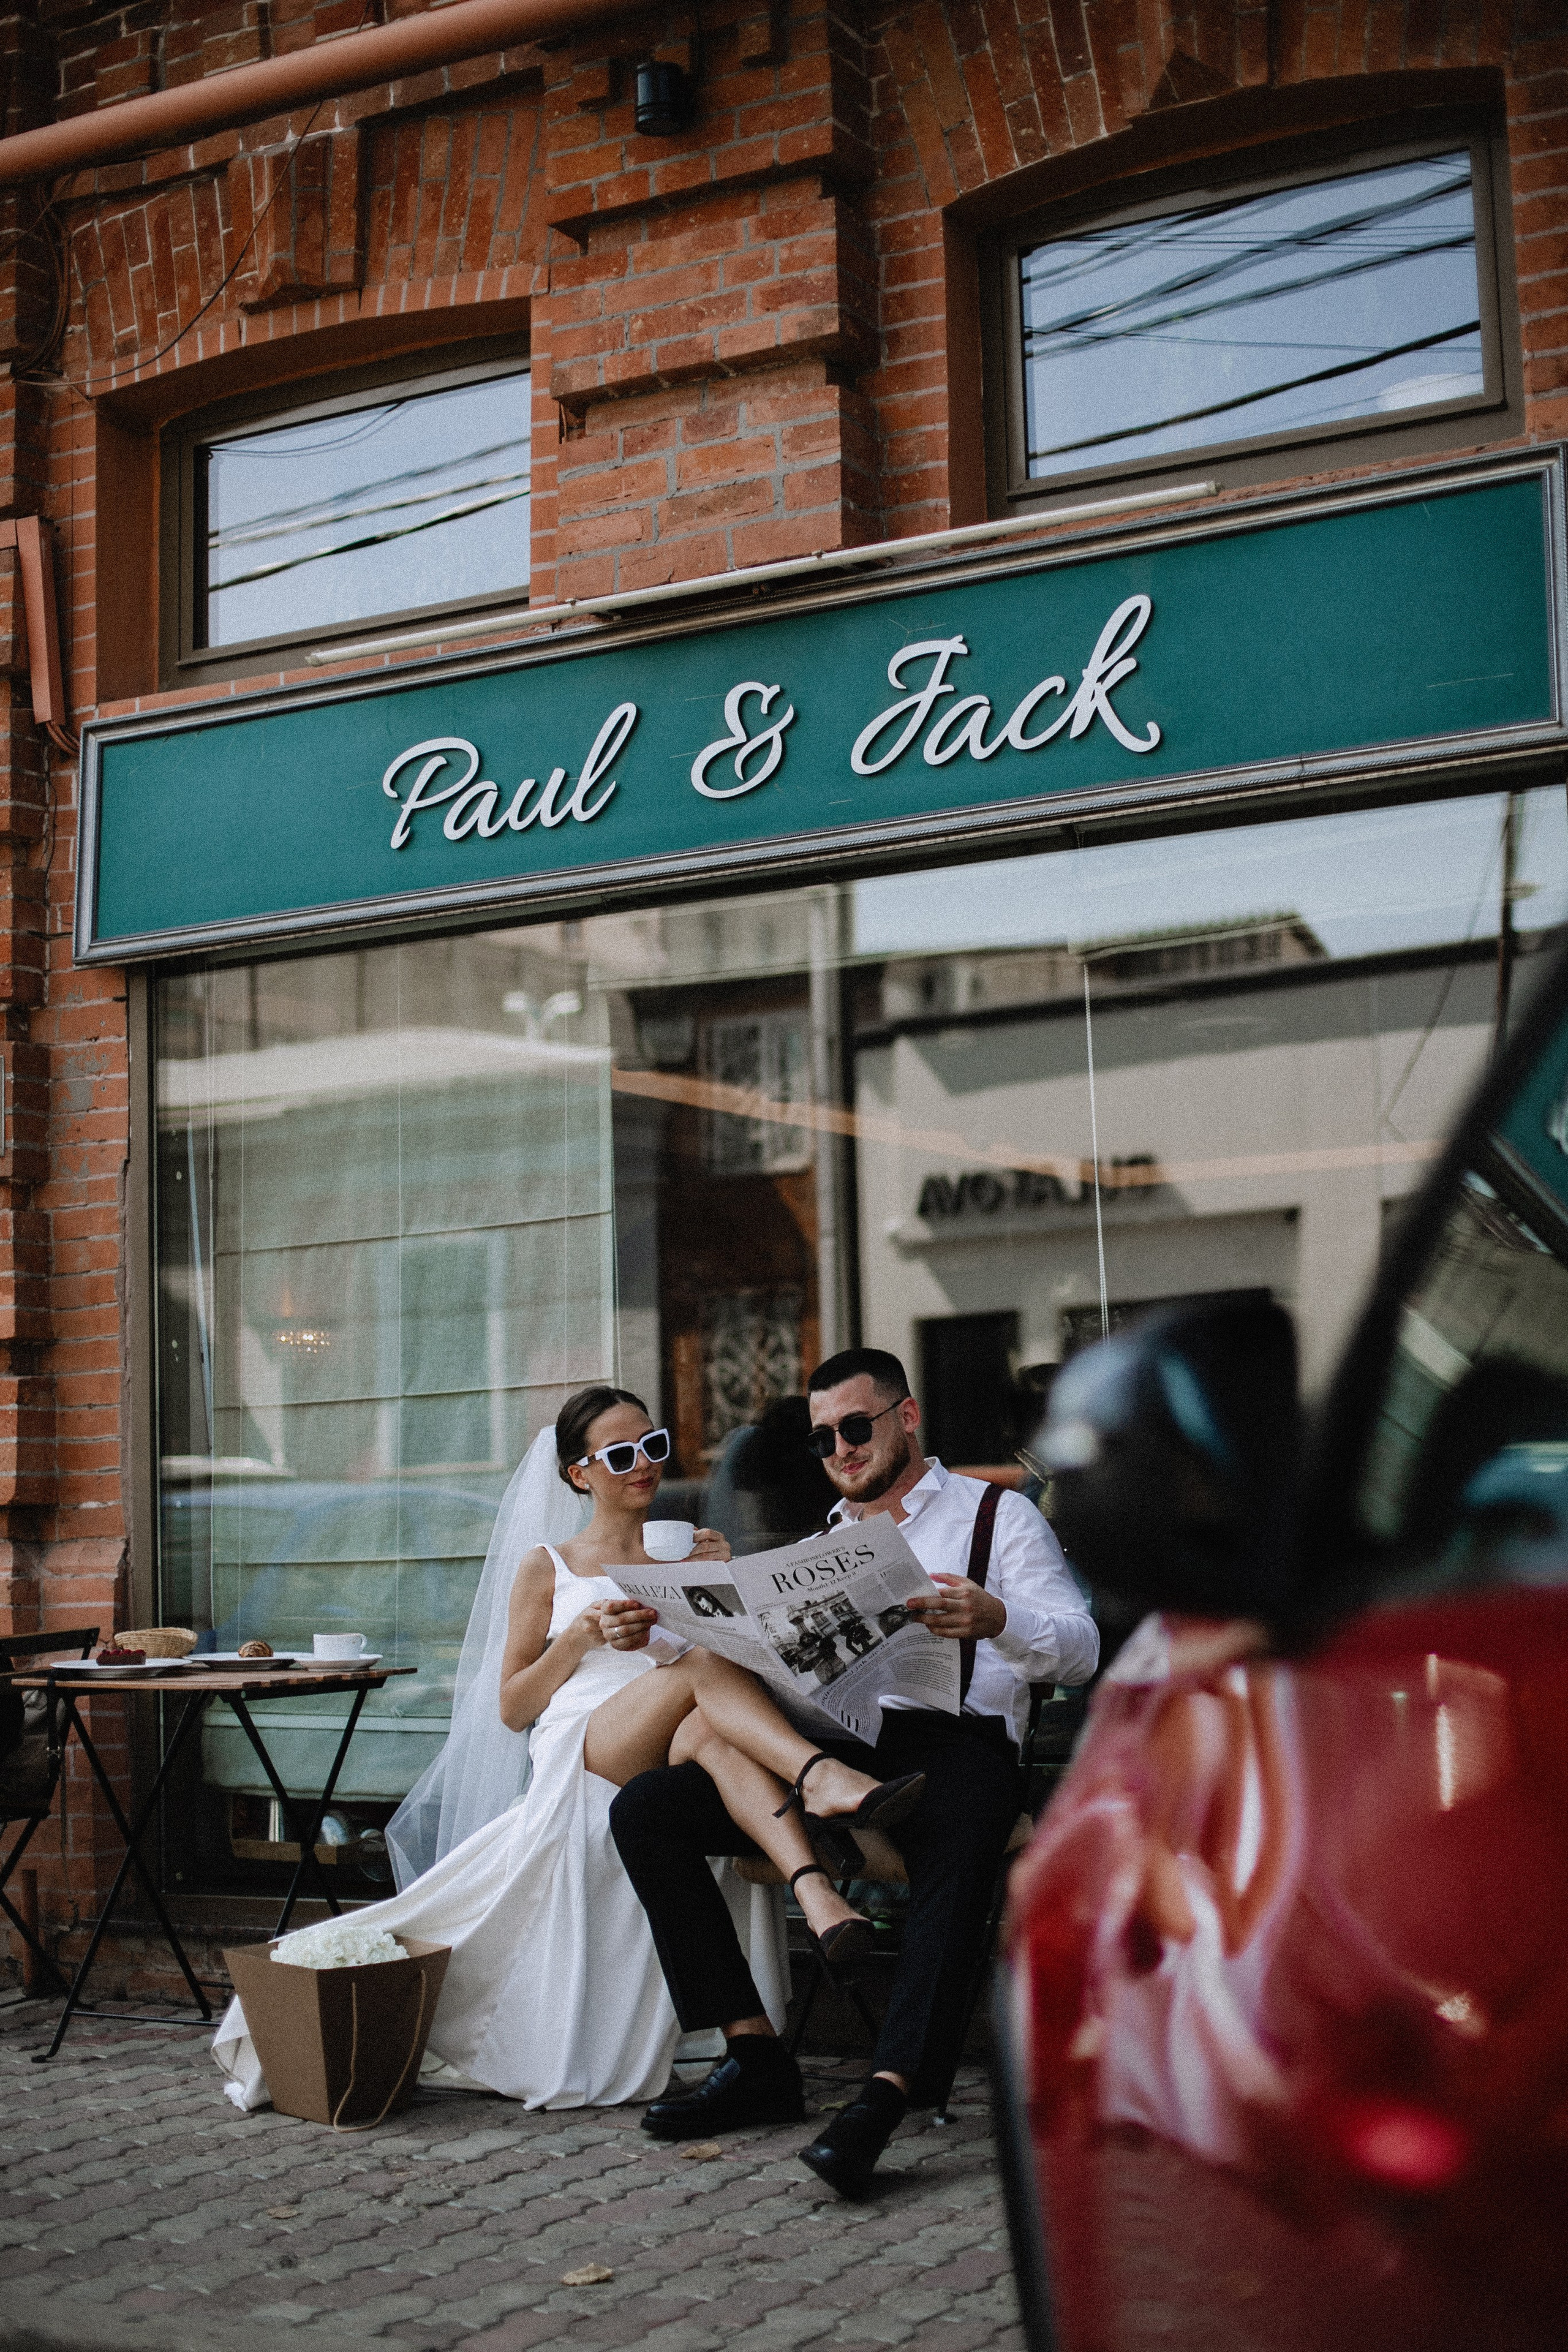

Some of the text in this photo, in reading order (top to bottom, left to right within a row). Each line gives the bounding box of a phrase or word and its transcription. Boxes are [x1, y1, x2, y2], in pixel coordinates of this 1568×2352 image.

[383, 594, 1161, 850] Paul & Jack
[769, 1544, 875, 1594] ROSES
